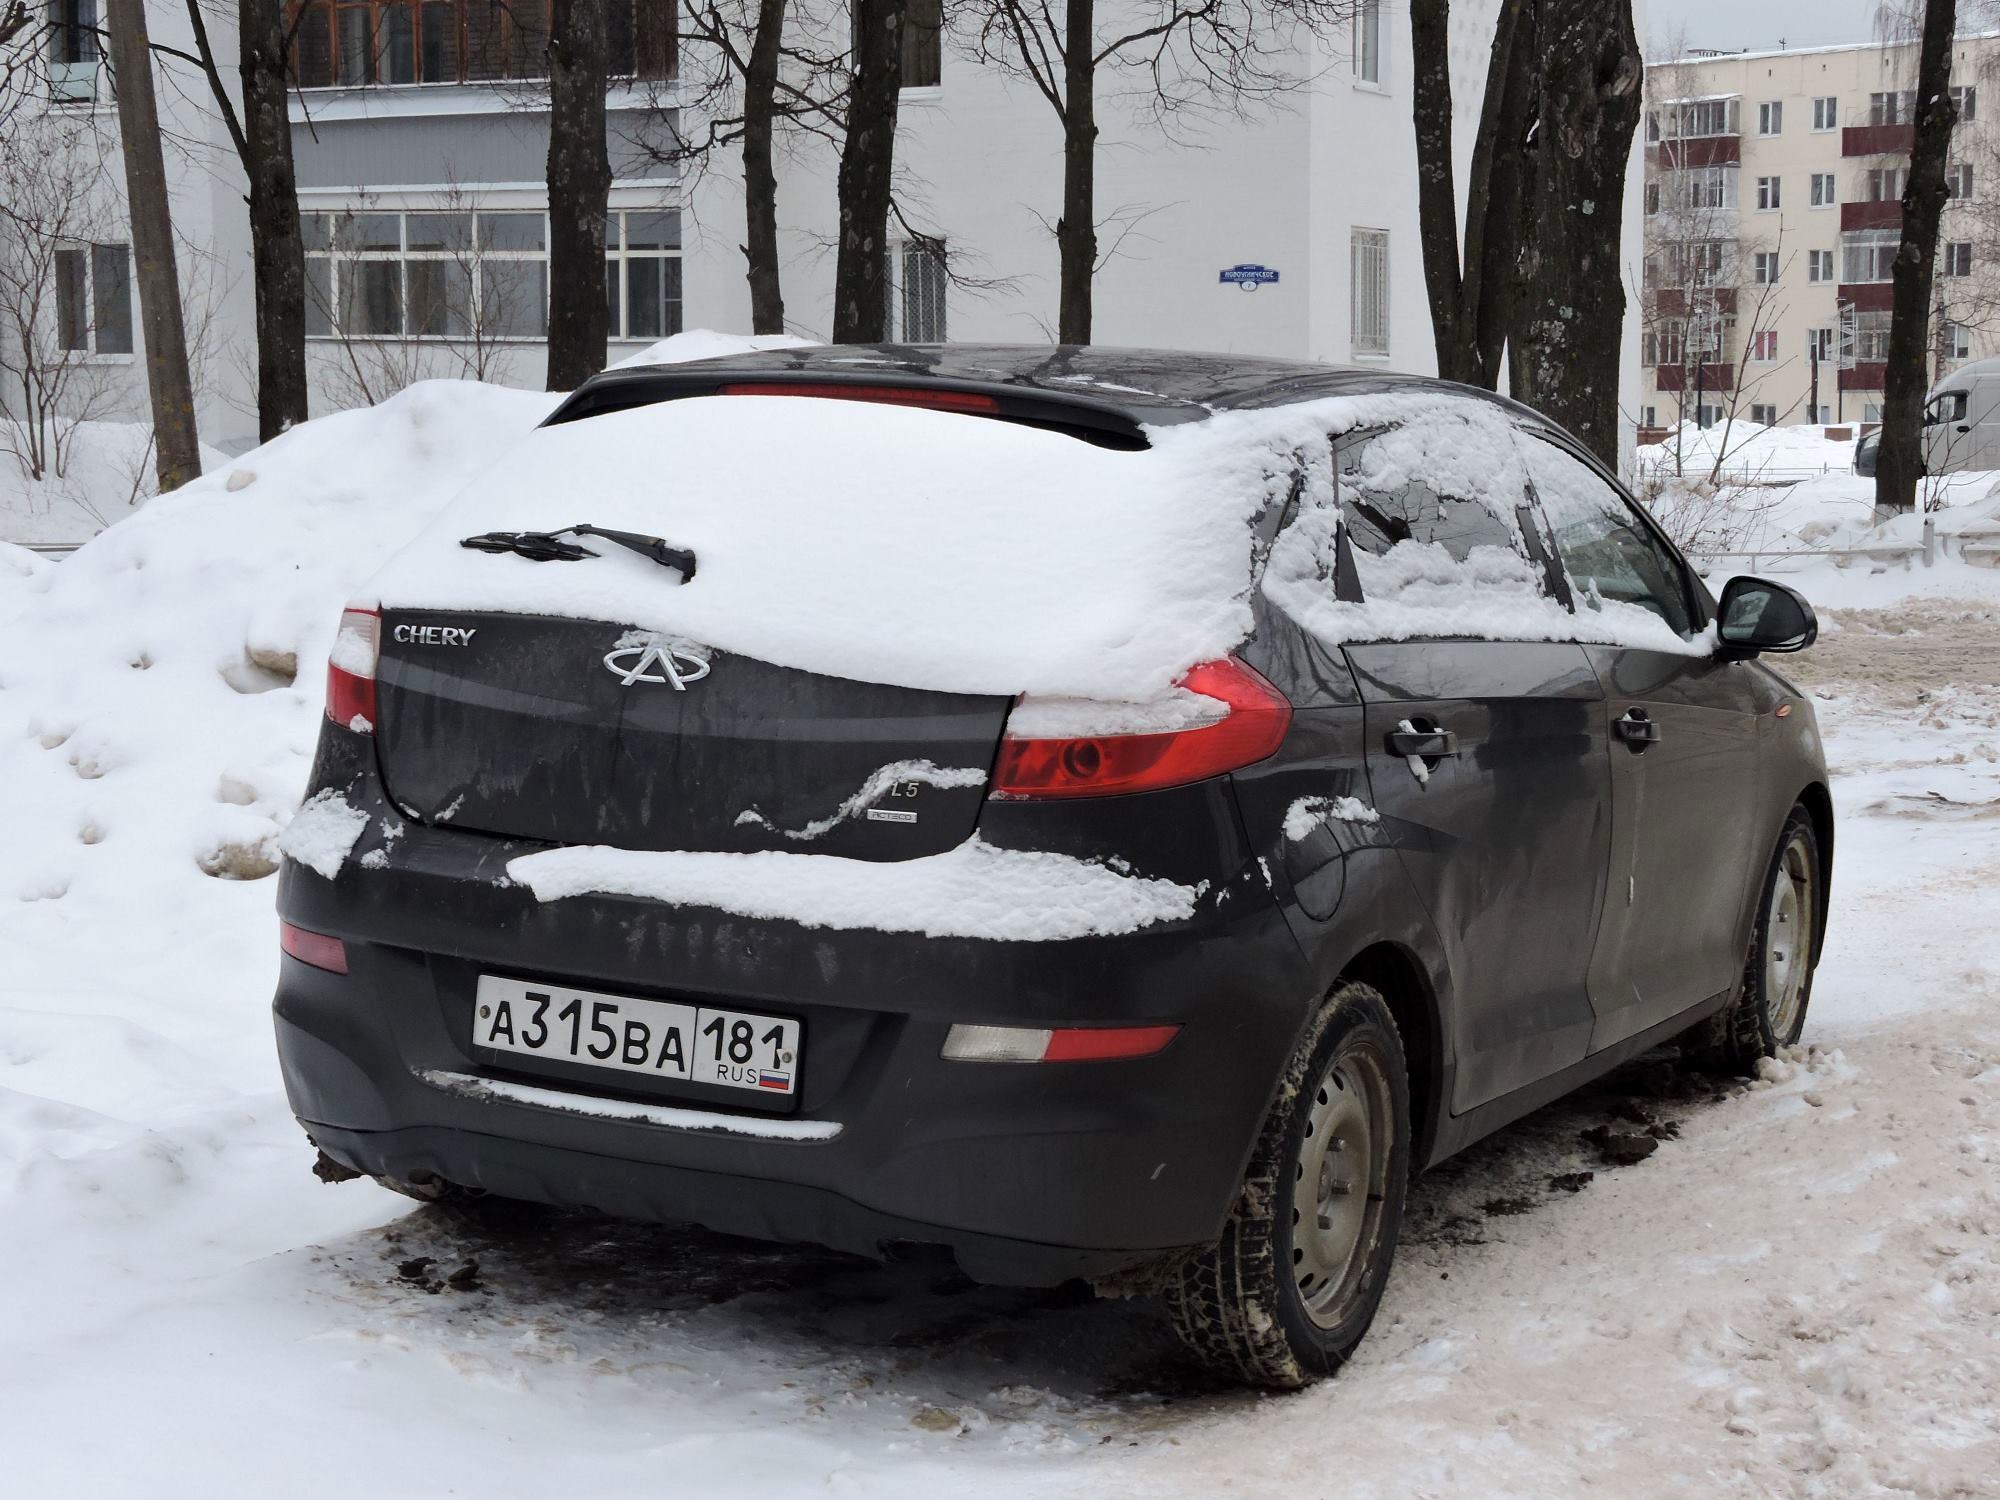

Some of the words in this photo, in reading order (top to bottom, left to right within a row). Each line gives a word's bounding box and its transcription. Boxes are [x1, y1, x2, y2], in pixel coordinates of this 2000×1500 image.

[394, 624, 476, 646] CHERY
[488, 991, 686, 1072] А315ВА
[703, 1016, 785, 1069] 181
[717, 1063, 757, 1084] RUS
